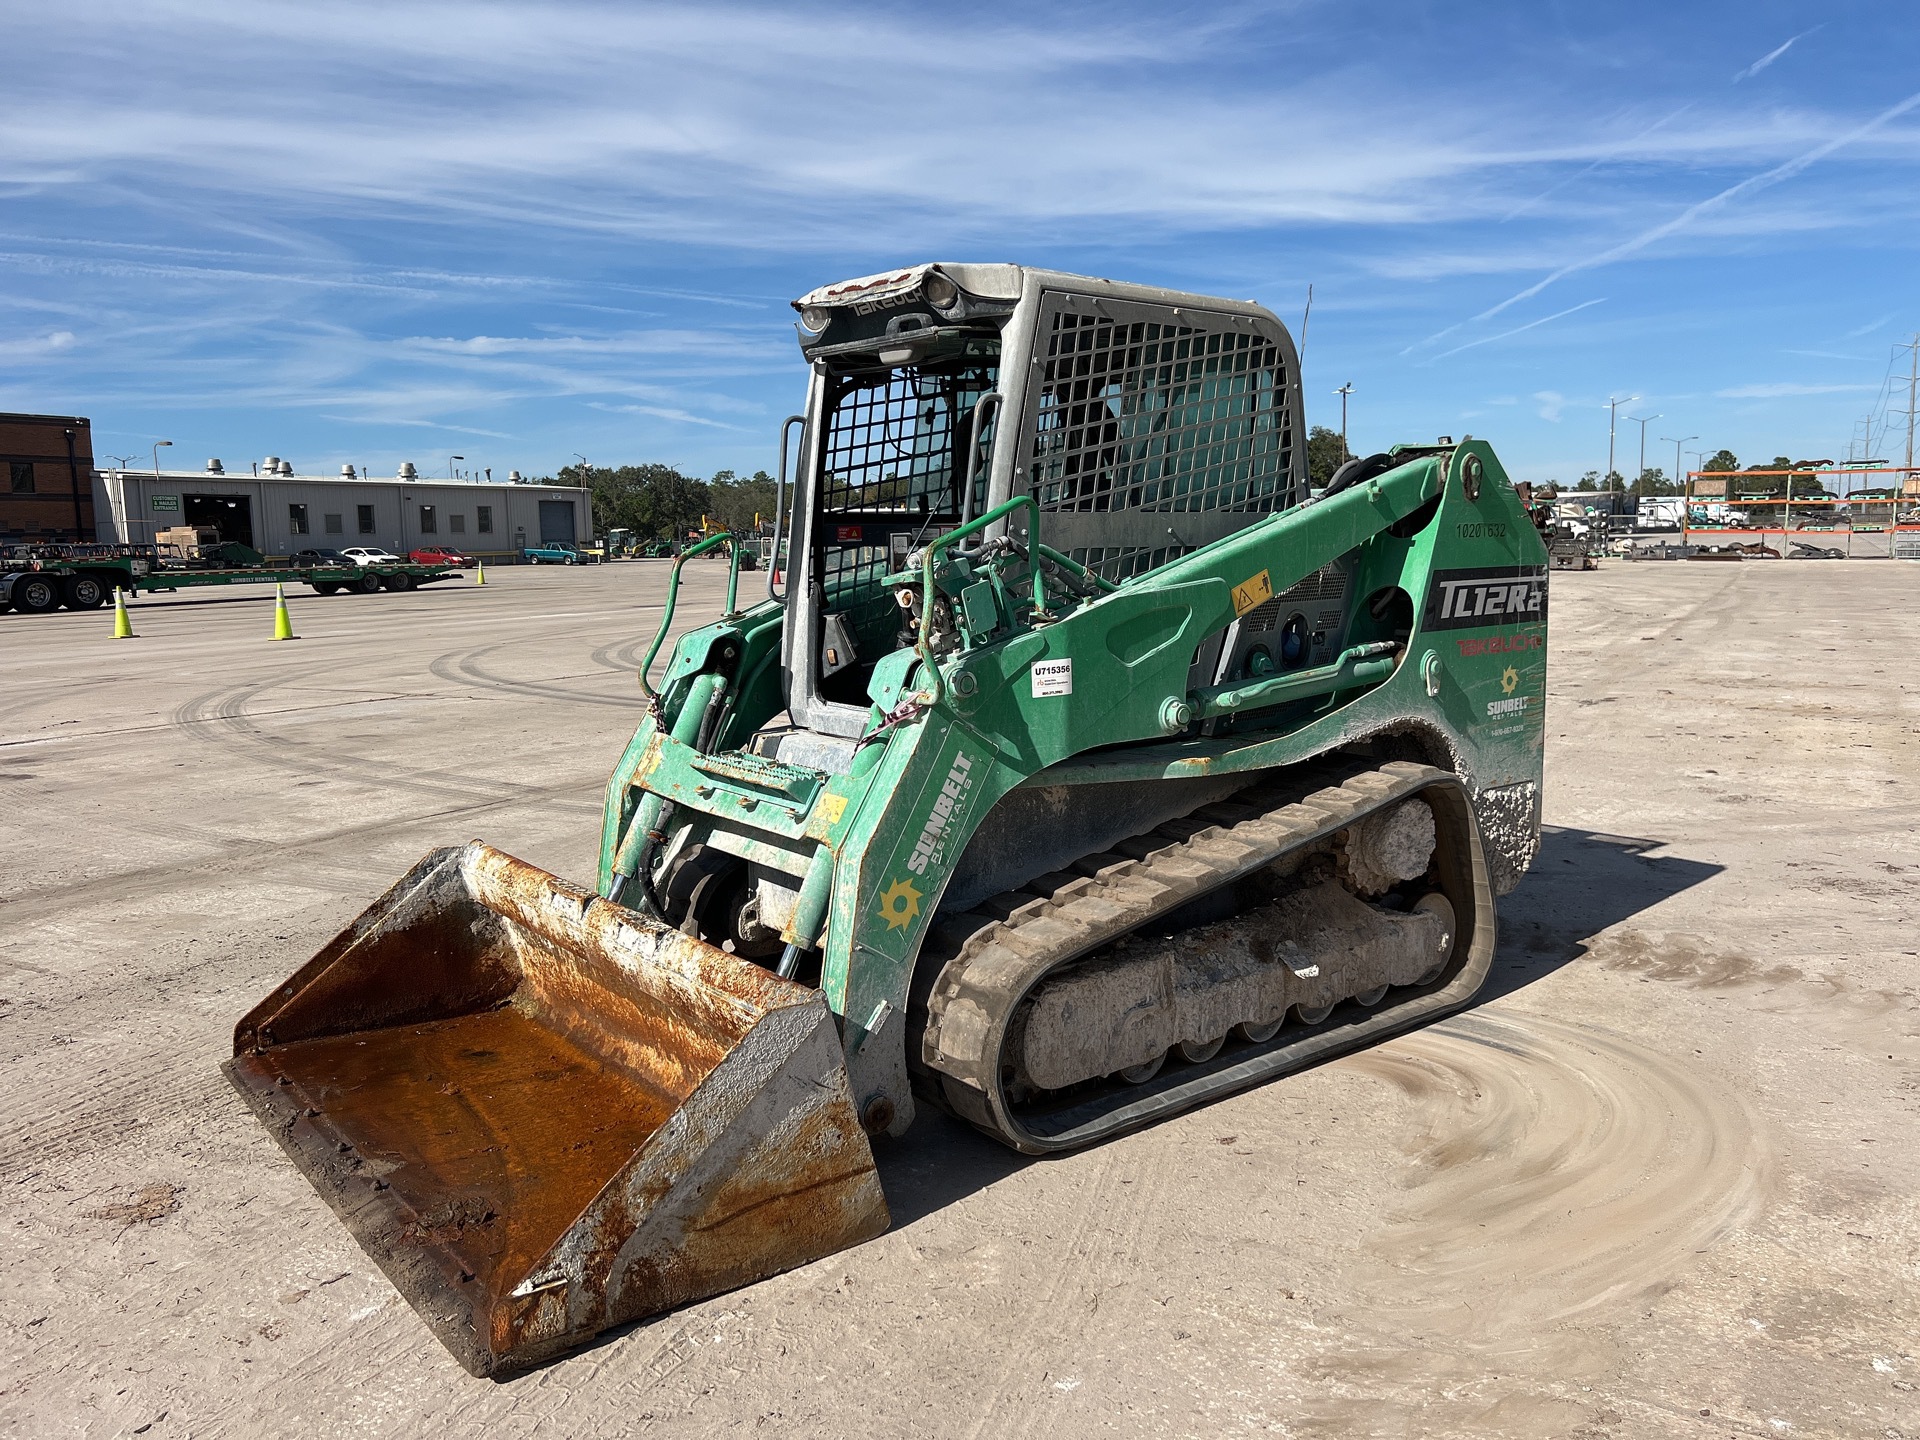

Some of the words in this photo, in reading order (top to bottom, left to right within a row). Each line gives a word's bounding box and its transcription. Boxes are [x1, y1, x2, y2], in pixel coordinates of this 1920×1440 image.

[847, 287, 923, 317] TAKEUCH
[1035, 665, 1071, 676] U715356
[907, 750, 972, 876] SUNBELT
[930, 778, 973, 864] RENTALS
